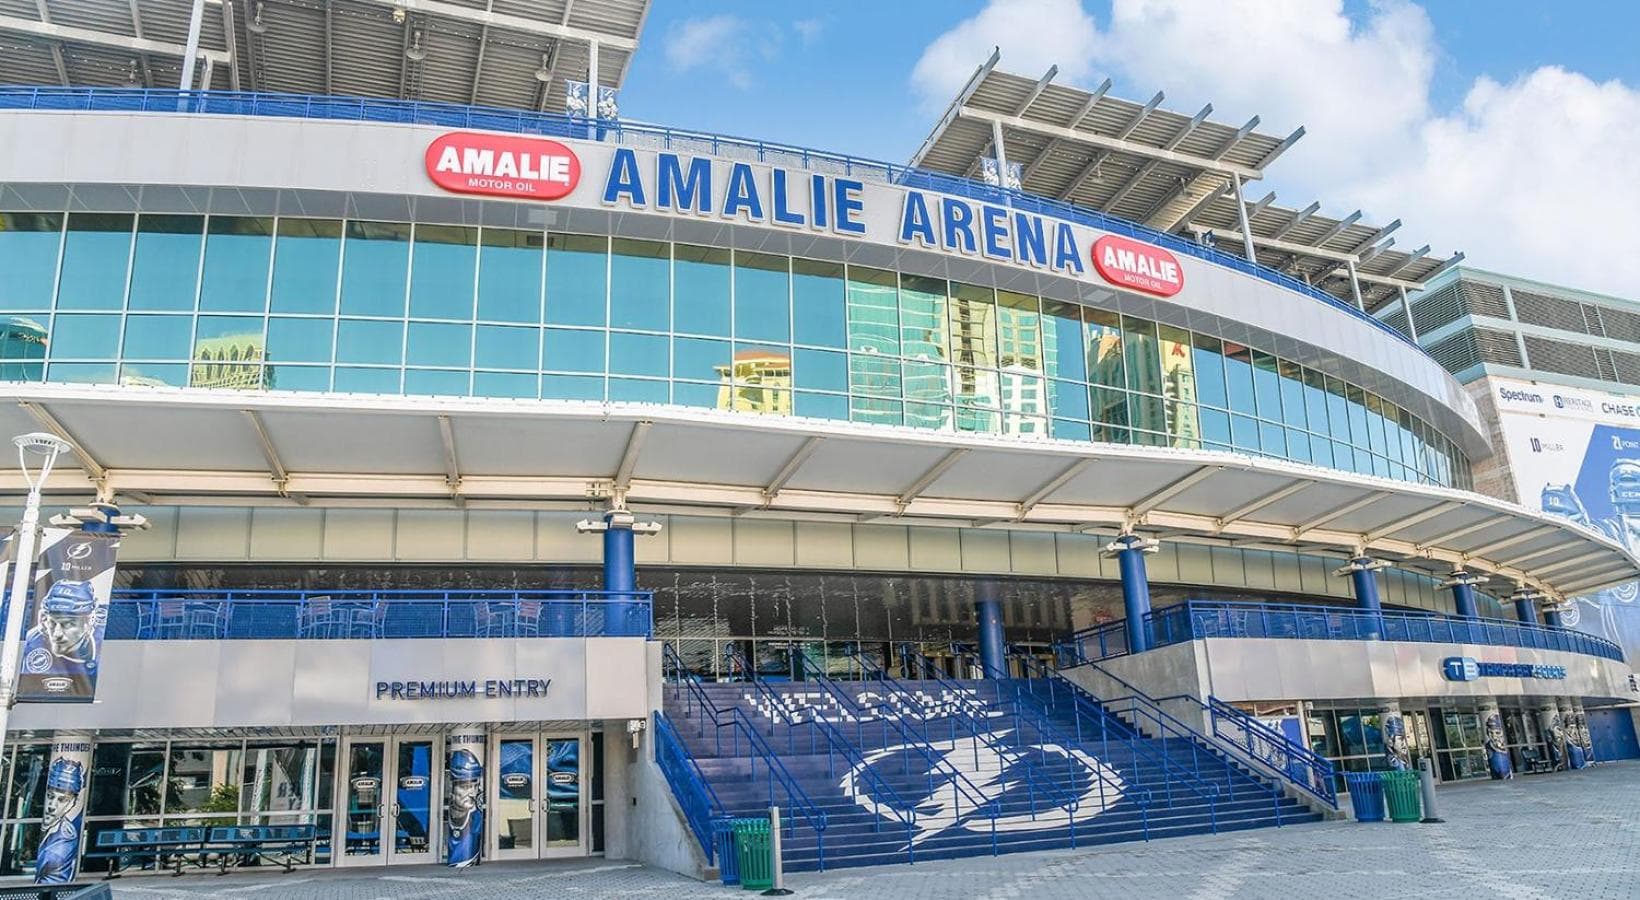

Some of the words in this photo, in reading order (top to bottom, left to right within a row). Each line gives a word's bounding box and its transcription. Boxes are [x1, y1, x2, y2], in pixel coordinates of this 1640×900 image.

[436, 146, 571, 183] AMALIE
[468, 178, 513, 190] MOTOR
[515, 182, 537, 192] OIL
[602, 147, 867, 236] AMALIE
[899, 190, 1085, 275] ARENA
[1103, 245, 1178, 285] AMALIE
[1499, 387, 1545, 404] Spectrum
[1601, 402, 1636, 417] CHASE
[1530, 437, 1542, 453] 10
[61, 562, 72, 571] 10
[376, 681, 477, 701] PREMIUM
[485, 678, 552, 699] ENTRY
